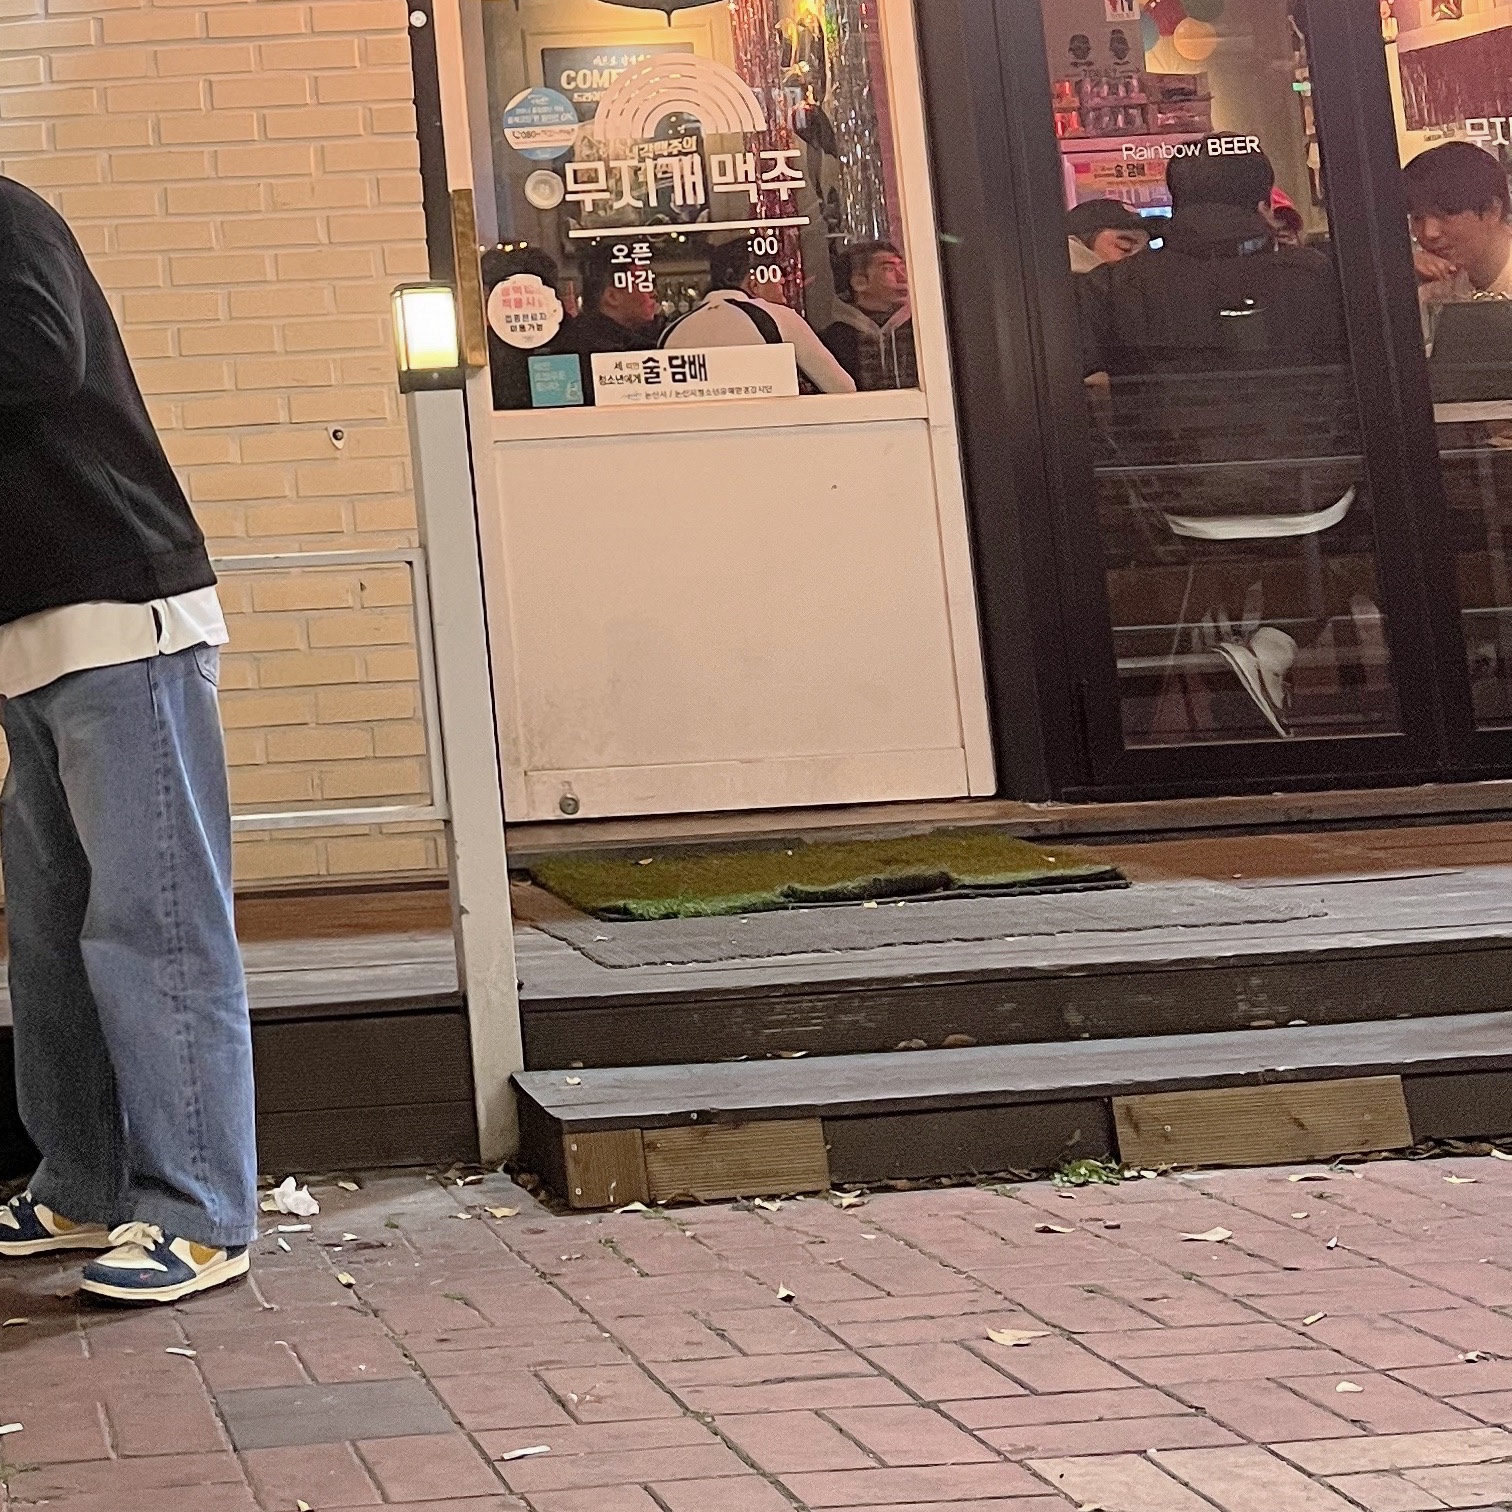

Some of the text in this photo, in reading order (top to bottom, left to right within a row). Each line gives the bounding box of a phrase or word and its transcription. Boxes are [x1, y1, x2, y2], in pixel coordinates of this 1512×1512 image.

[1121, 135, 1261, 161] Rainbow BEER
[611, 242, 653, 265] 오픈
[613, 269, 656, 294] 마감
